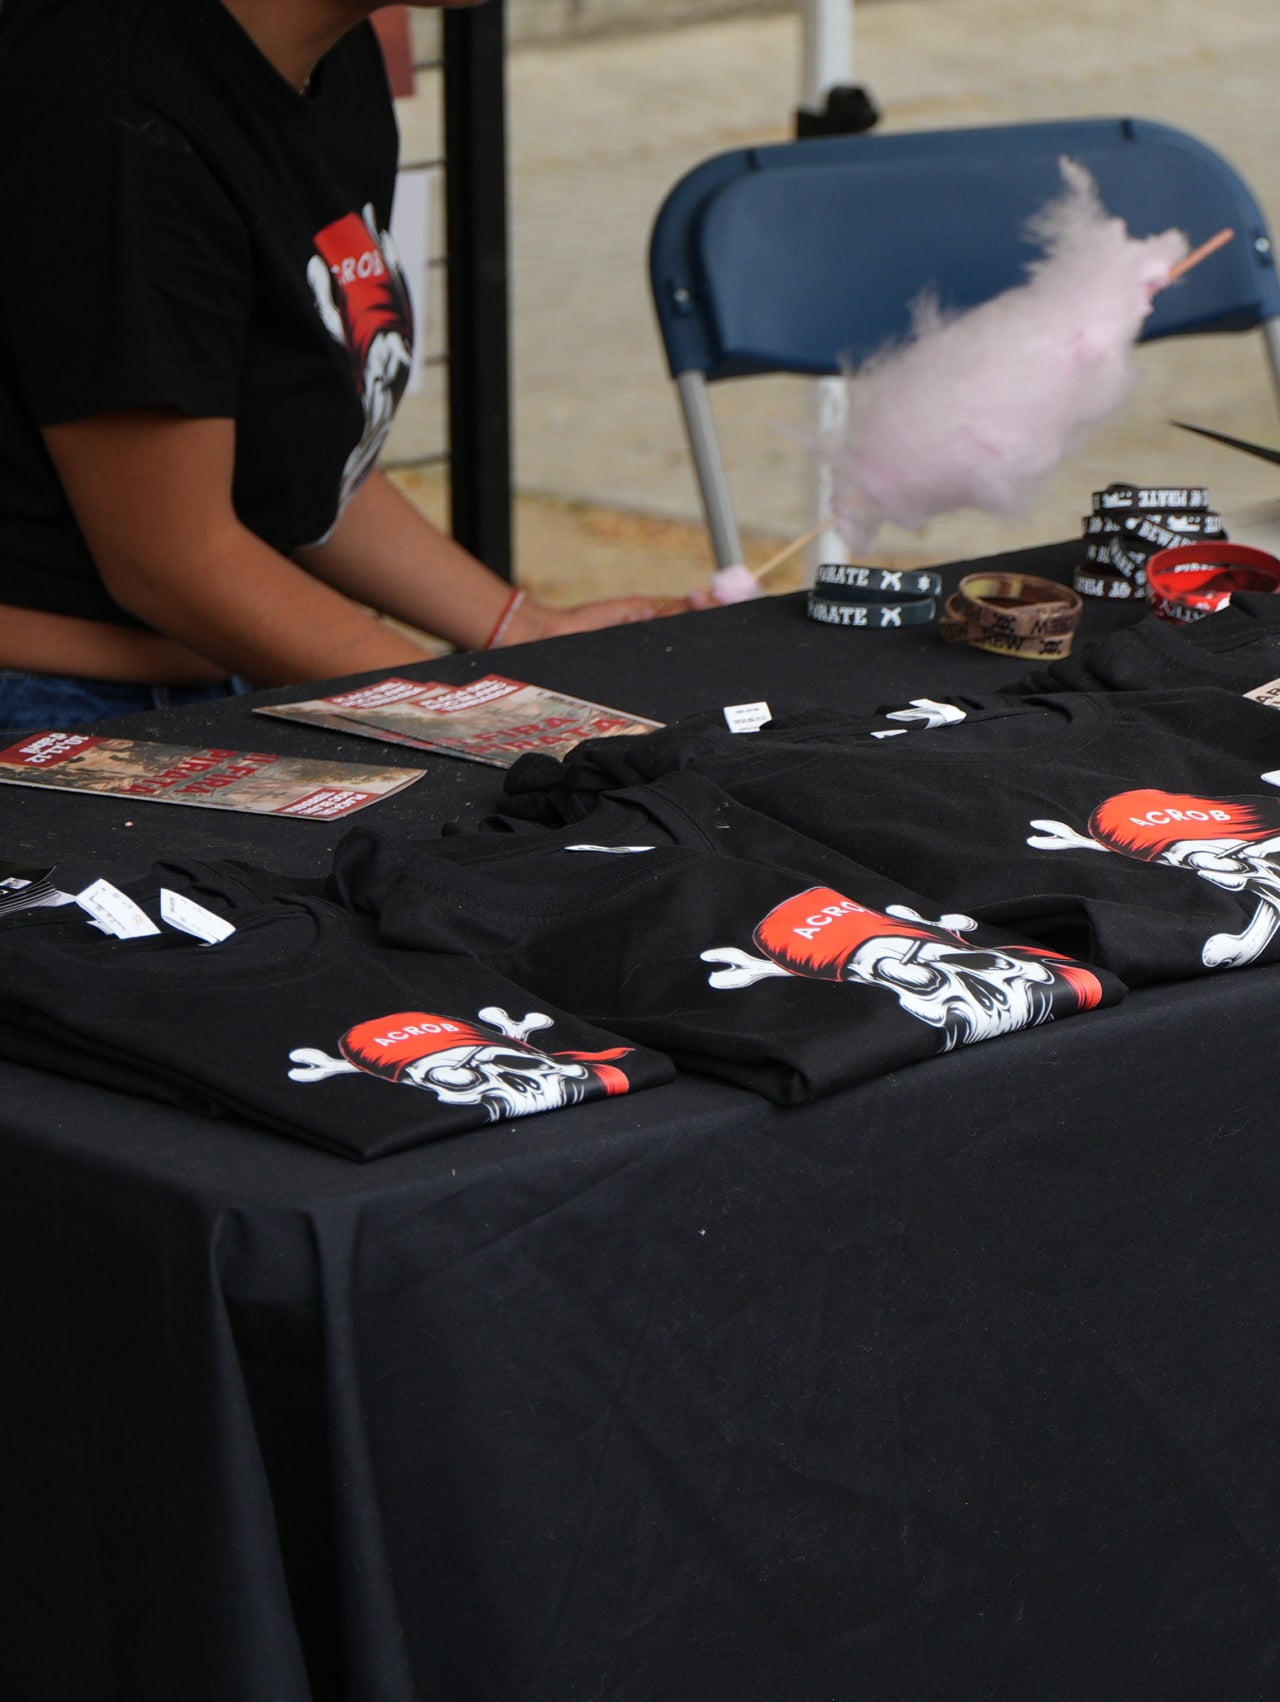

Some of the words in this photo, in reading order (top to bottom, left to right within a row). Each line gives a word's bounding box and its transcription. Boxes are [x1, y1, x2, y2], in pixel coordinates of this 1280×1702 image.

[1137, 519, 1198, 549] BEWAR
[472, 717, 580, 742] FIRA
[118, 748, 240, 794] PIRATA
[174, 765, 259, 794] FIRA
[1130, 804, 1233, 831] ACROB
[792, 901, 866, 941] ACRO
[373, 1022, 461, 1049] ACROB
